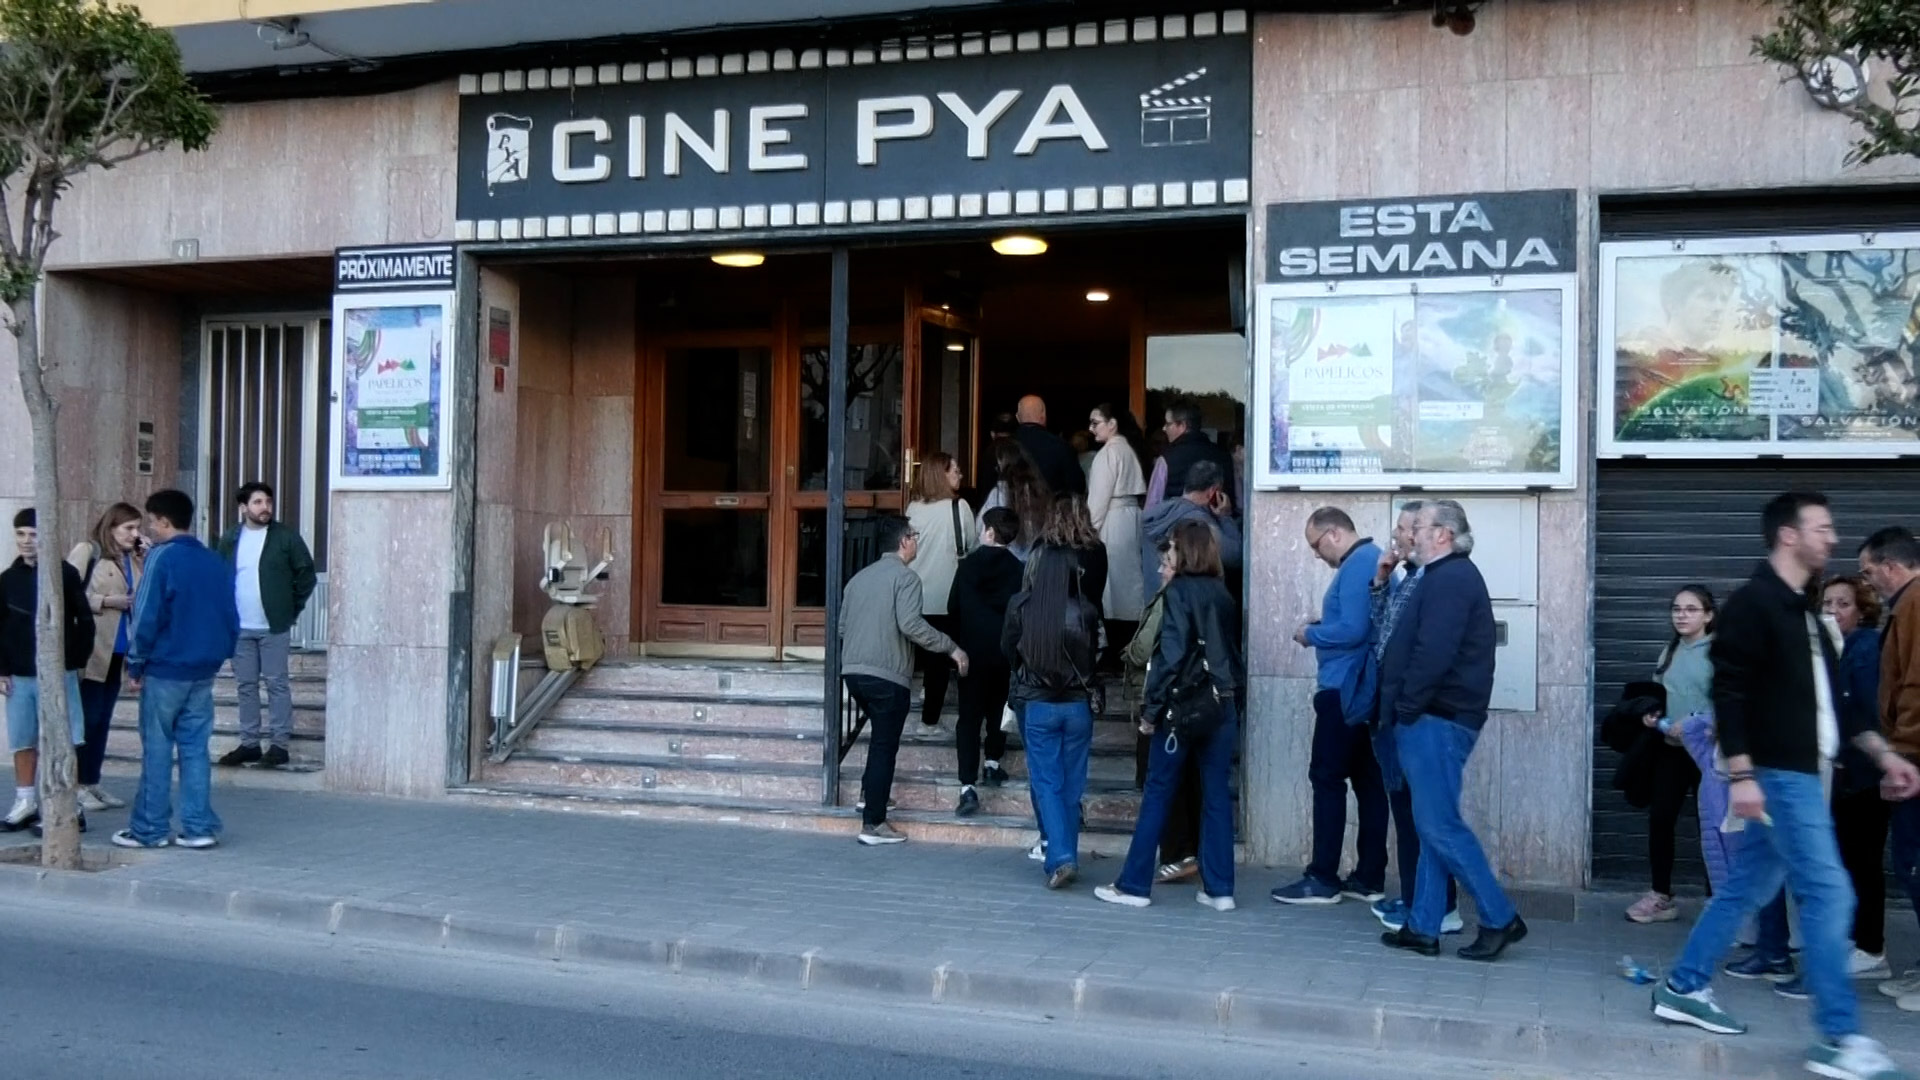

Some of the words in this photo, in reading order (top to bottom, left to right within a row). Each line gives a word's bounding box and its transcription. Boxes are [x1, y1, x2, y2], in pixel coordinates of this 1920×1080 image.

[551, 104, 809, 184] CINE
[857, 84, 1108, 166] PYA
[1340, 201, 1493, 238] ESTA
[1280, 237, 1558, 276] SEMANA
[368, 378, 423, 389] PAPELICOS
[1304, 366, 1384, 379] PAPELICOS
